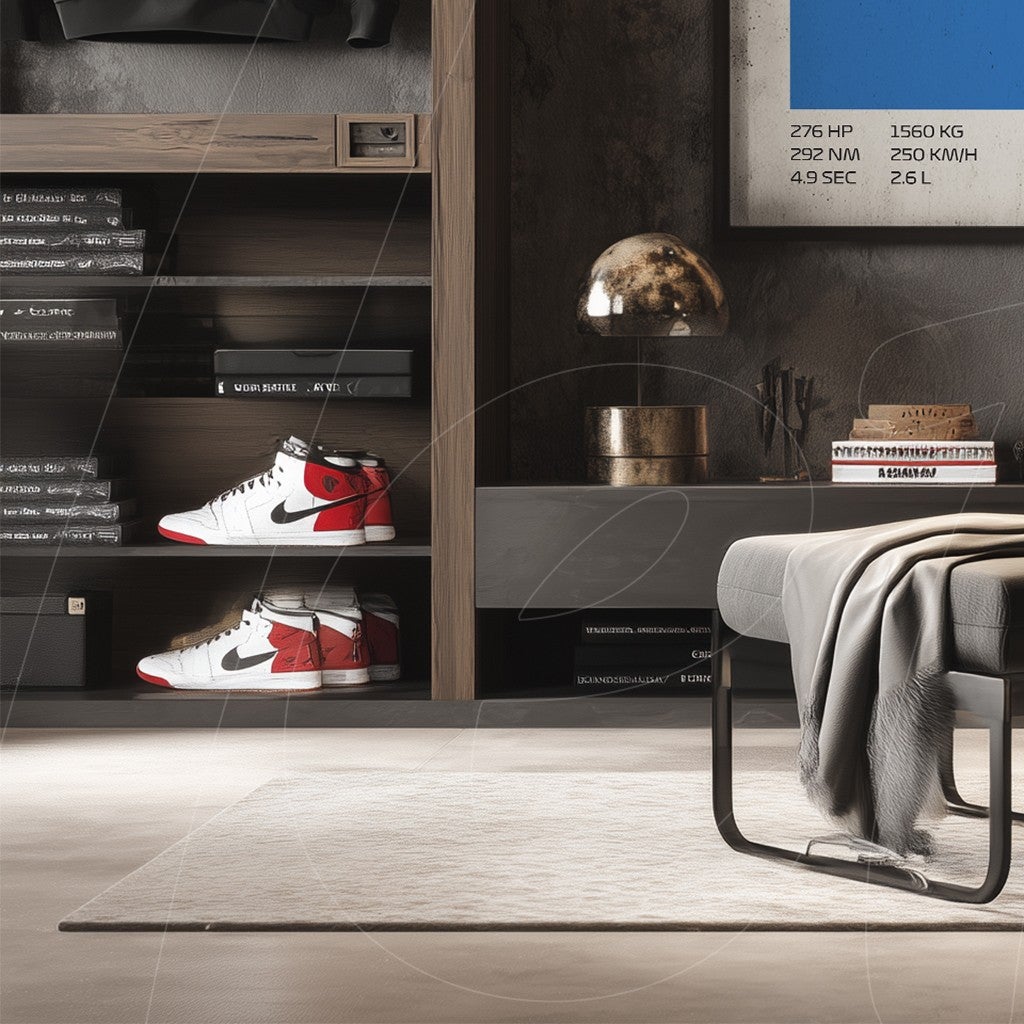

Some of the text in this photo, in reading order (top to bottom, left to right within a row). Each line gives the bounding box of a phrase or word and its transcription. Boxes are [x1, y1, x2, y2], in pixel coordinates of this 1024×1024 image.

[790, 124, 854, 138] 276 HP
[890, 124, 964, 139] 1560 KG
[790, 147, 861, 162] 292 NM
[890, 147, 977, 163] 250 KM/H
[790, 170, 857, 185] 4.9 SEC
[890, 170, 932, 185] 2.6 L
